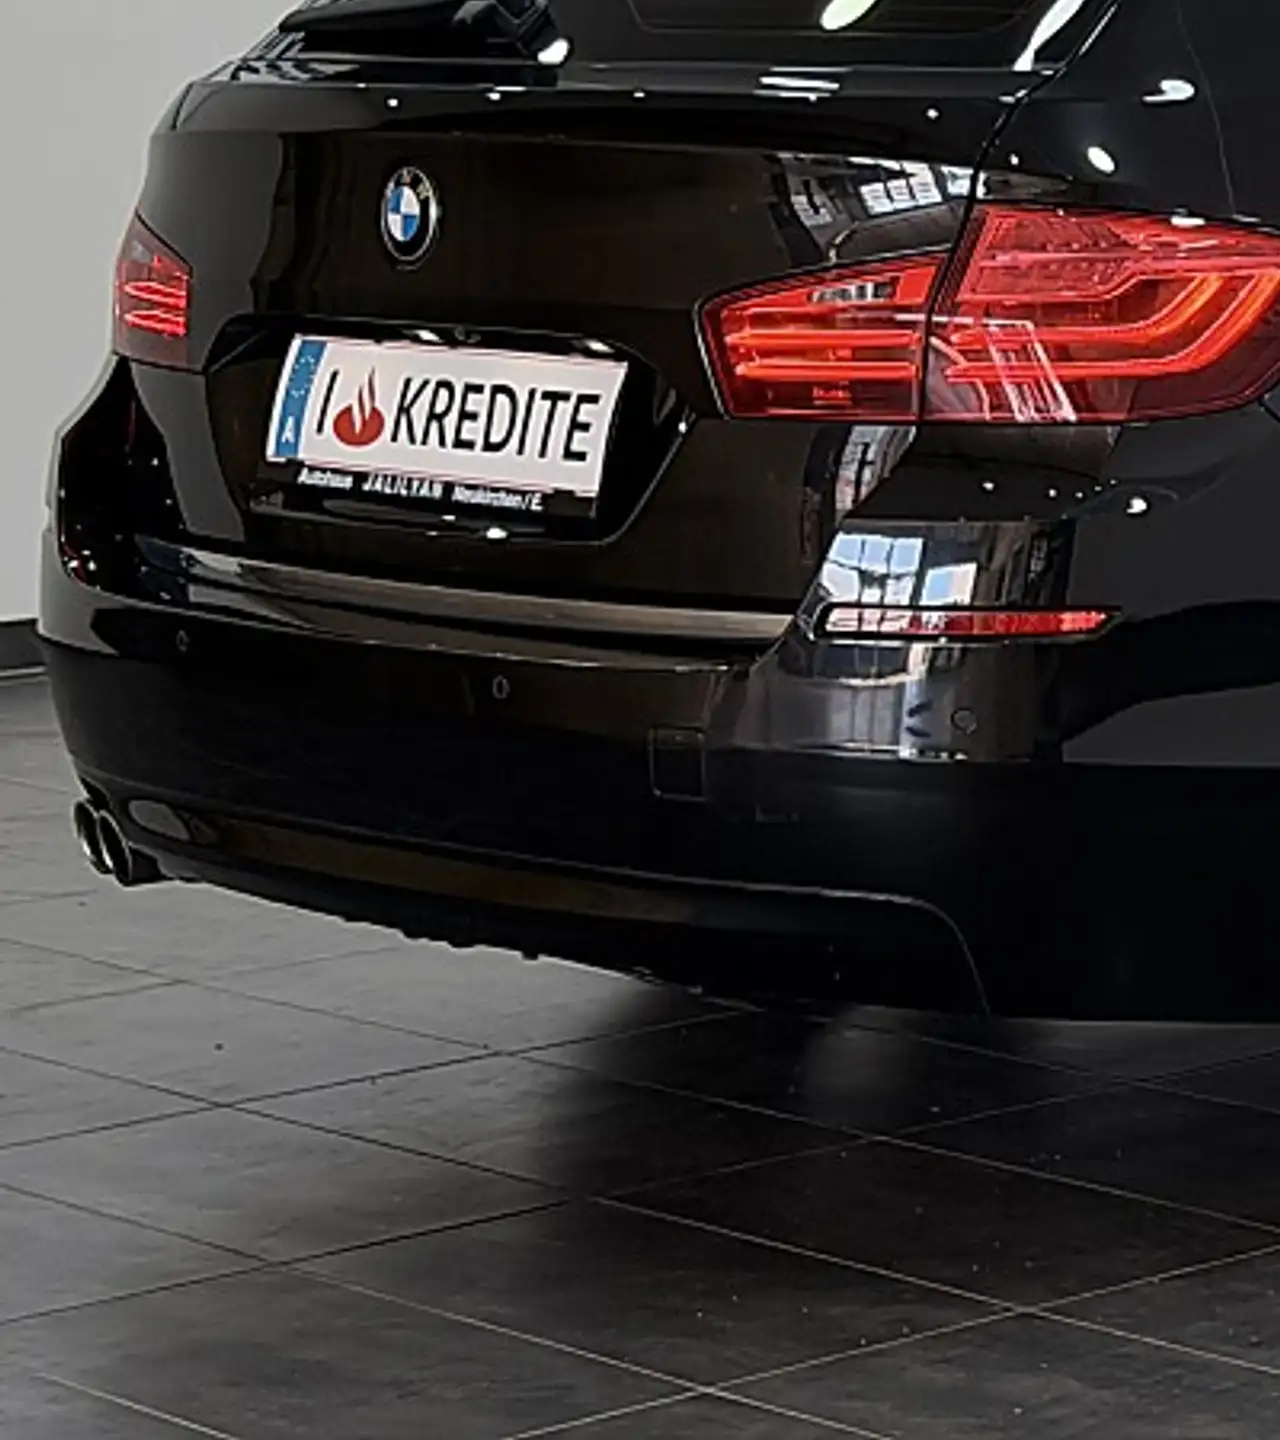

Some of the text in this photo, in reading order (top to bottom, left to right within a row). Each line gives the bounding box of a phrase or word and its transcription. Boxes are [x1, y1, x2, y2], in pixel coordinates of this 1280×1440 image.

[280, 415, 295, 444] A
[391, 377, 600, 462] KREDITE
[361, 472, 444, 500] JALILYAN
